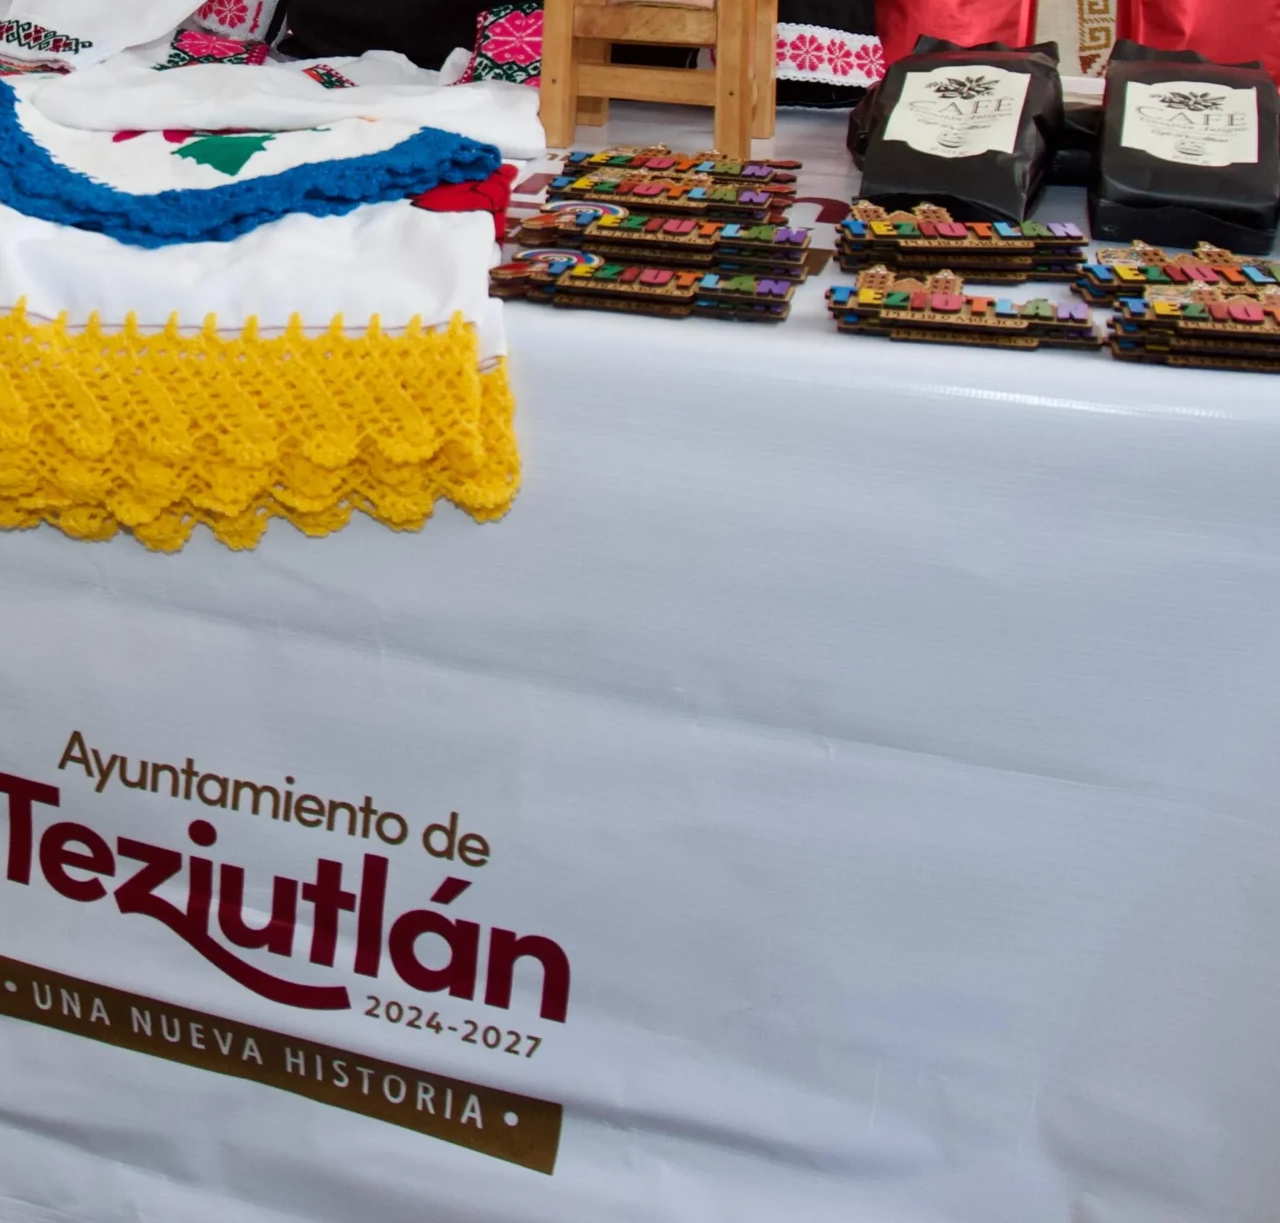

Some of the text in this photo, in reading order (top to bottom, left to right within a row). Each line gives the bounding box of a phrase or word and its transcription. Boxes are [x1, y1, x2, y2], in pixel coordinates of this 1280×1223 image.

[1082, 264, 1280, 286] TEZIUTL
[58, 730, 491, 868] Ayuntamiento de
[31, 980, 484, 1130] UNA NUEVA HISTORIA
[364, 995, 543, 1059] 2024-2027
